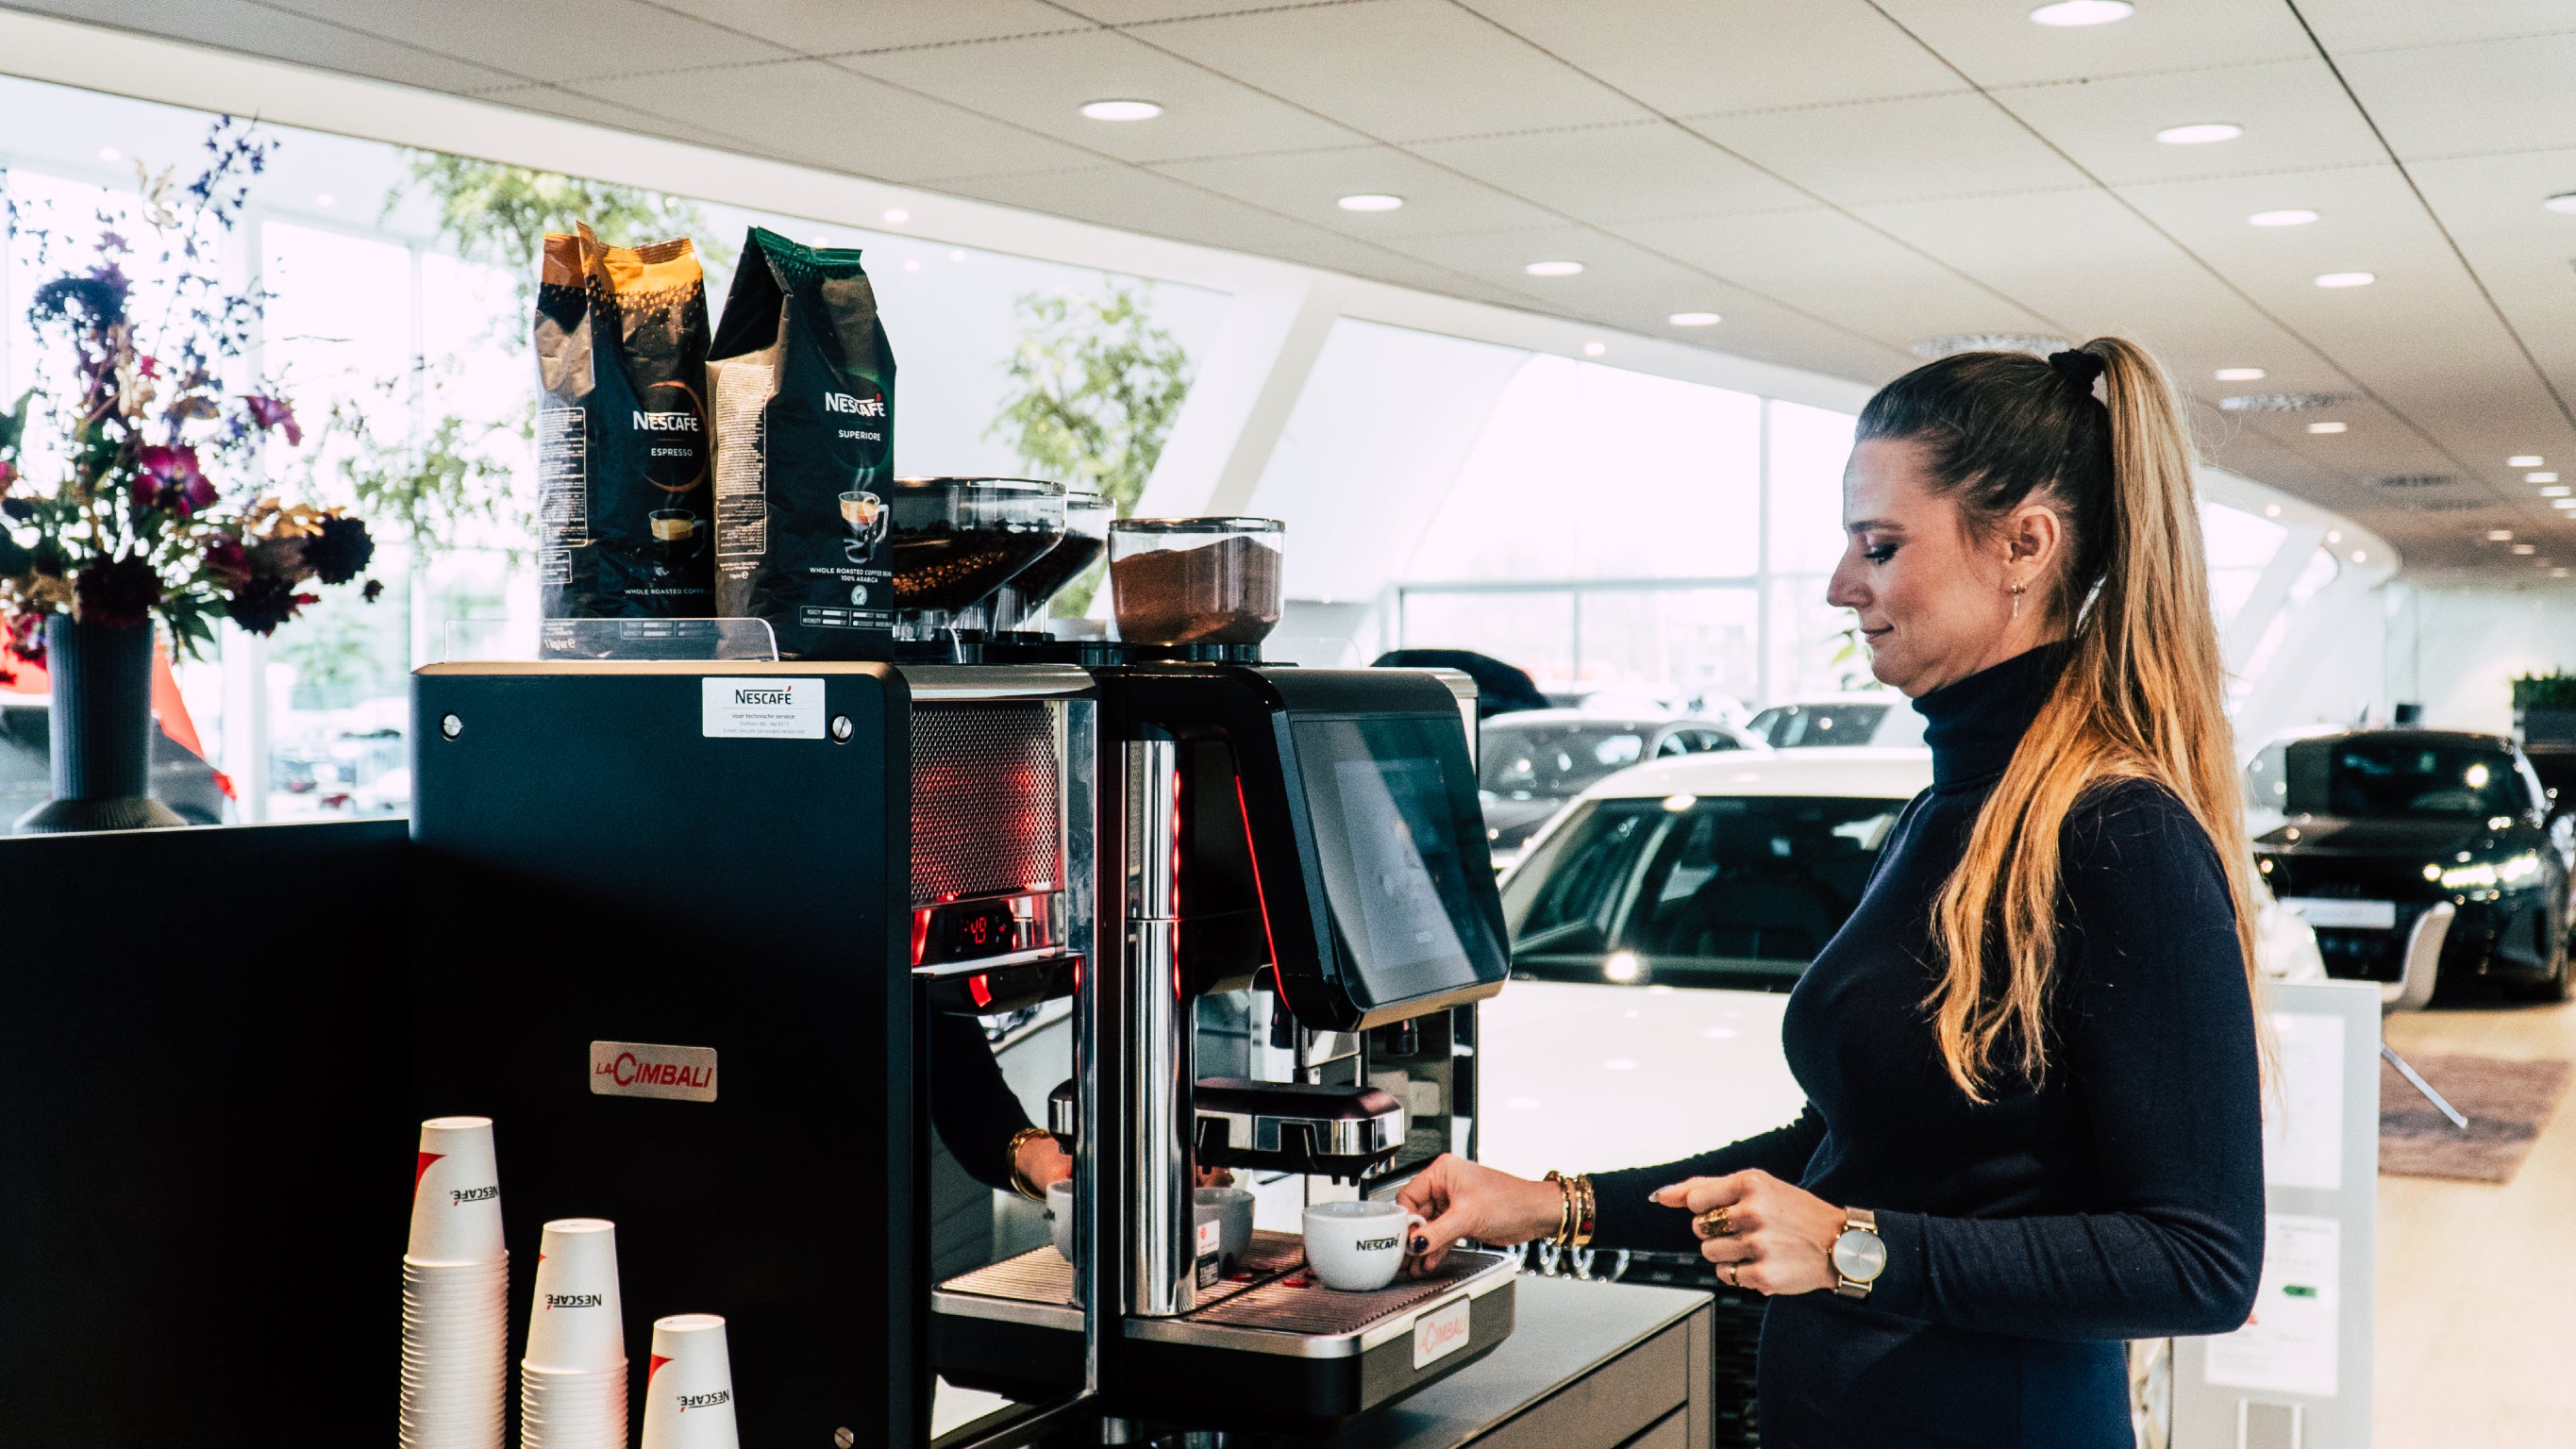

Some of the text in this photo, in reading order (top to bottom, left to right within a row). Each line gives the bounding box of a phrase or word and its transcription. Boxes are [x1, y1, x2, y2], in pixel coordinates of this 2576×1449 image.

[826, 391, 886, 417] NESCAFÉ
[633, 408, 698, 432] NESCAFÉ
[838, 429, 881, 441] SUPERIORE
[651, 447, 693, 457] ESPRESSO
[856, 575, 878, 584] ARABICA
[735, 685, 793, 705] NESCAFÉ
[613, 1052, 713, 1089] CIMBALI
[453, 1185, 499, 1207] NESCAFÉ
[546, 1293, 602, 1310] NESCAFÉ
[678, 1389, 730, 1413] NESCAFÉ
